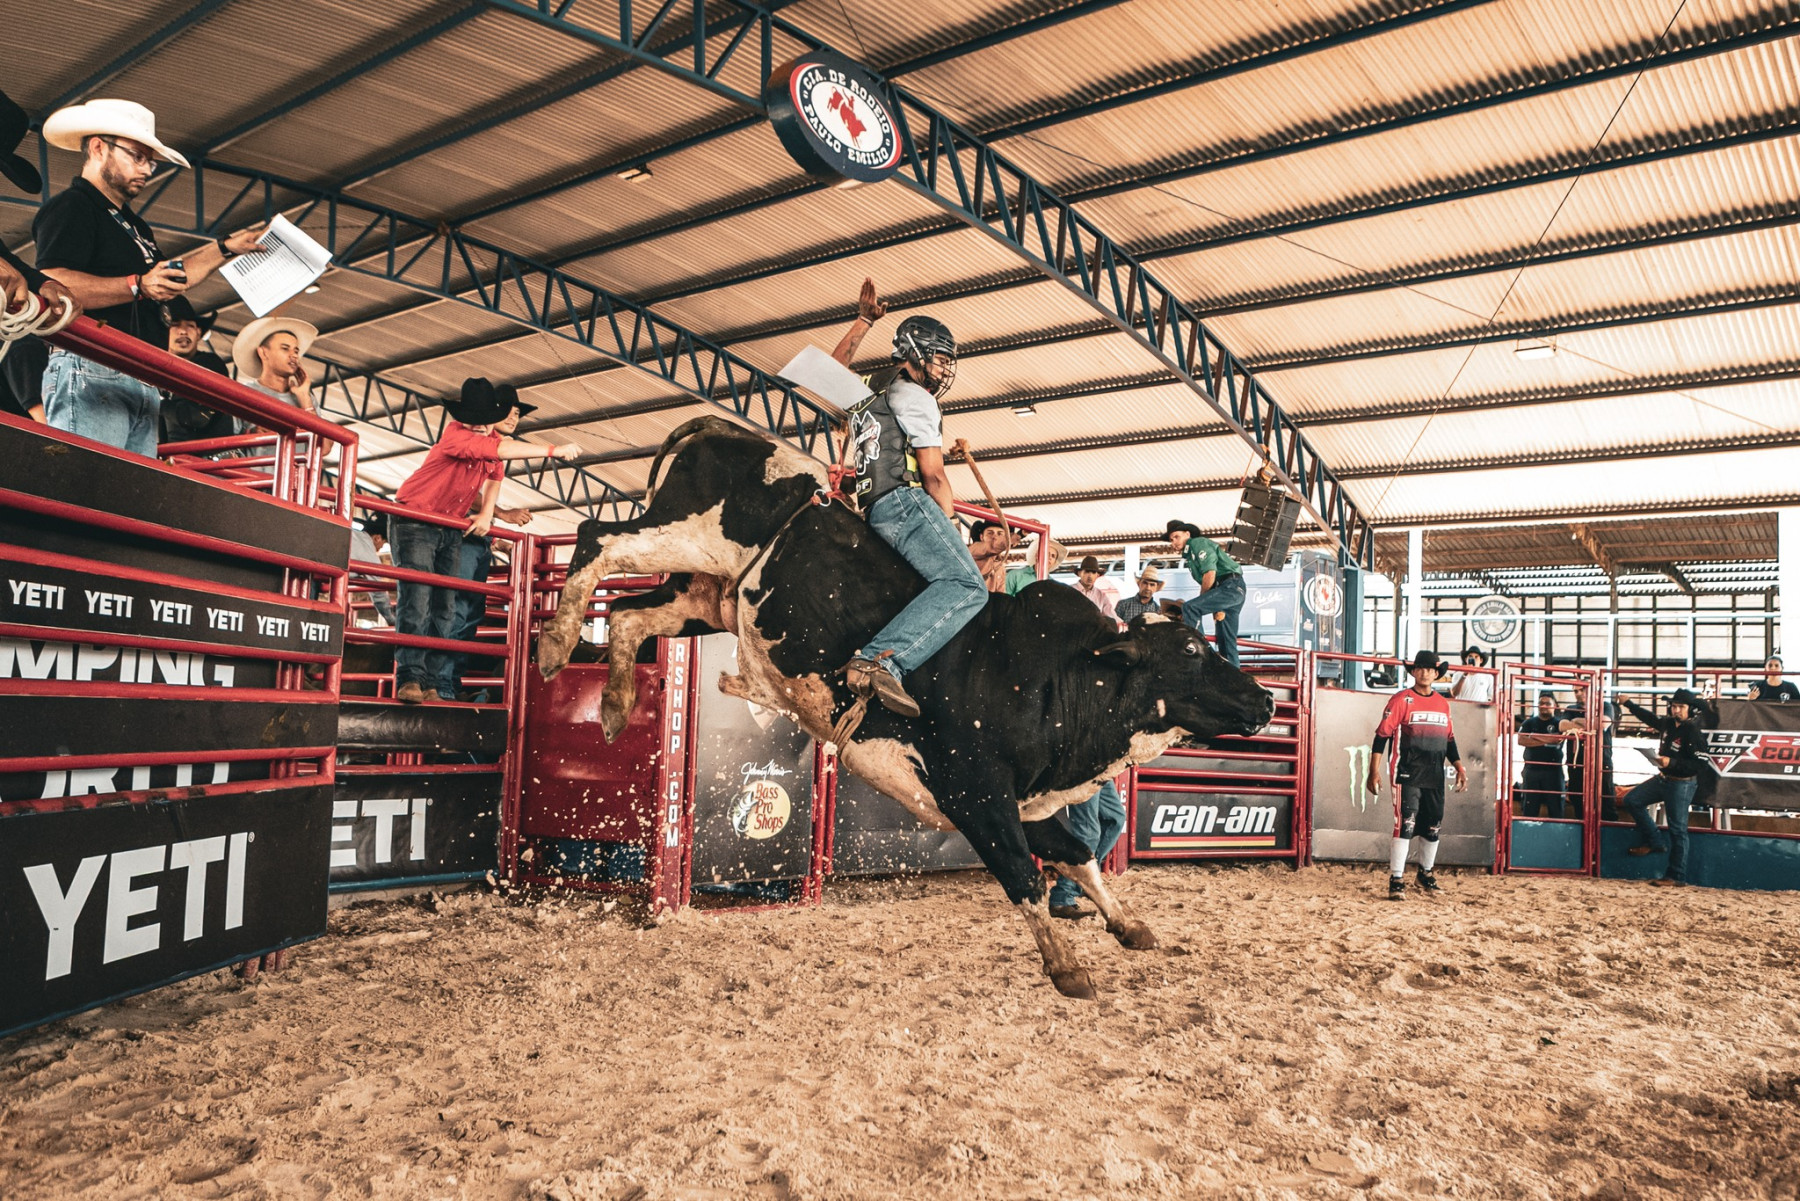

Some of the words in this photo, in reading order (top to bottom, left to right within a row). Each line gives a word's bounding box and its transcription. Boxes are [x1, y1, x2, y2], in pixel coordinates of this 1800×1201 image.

[803, 69, 827, 90] CIA.
[829, 69, 847, 85] DE
[850, 79, 891, 135] RODEIO
[804, 103, 842, 154] PAULO
[847, 147, 889, 165] EMILIO
[8, 579, 66, 610] YETI
[85, 589, 134, 618] YETI
[150, 599, 193, 625] YETI
[206, 607, 244, 632] YETI
[256, 615, 290, 638] YETI
[300, 621, 330, 642] YETI
[1784, 765, 1800, 774] B
[755, 783, 779, 800] Bass
[755, 798, 773, 815] Pro
[1150, 804, 1277, 834] can-am
[753, 813, 784, 833] Shops
